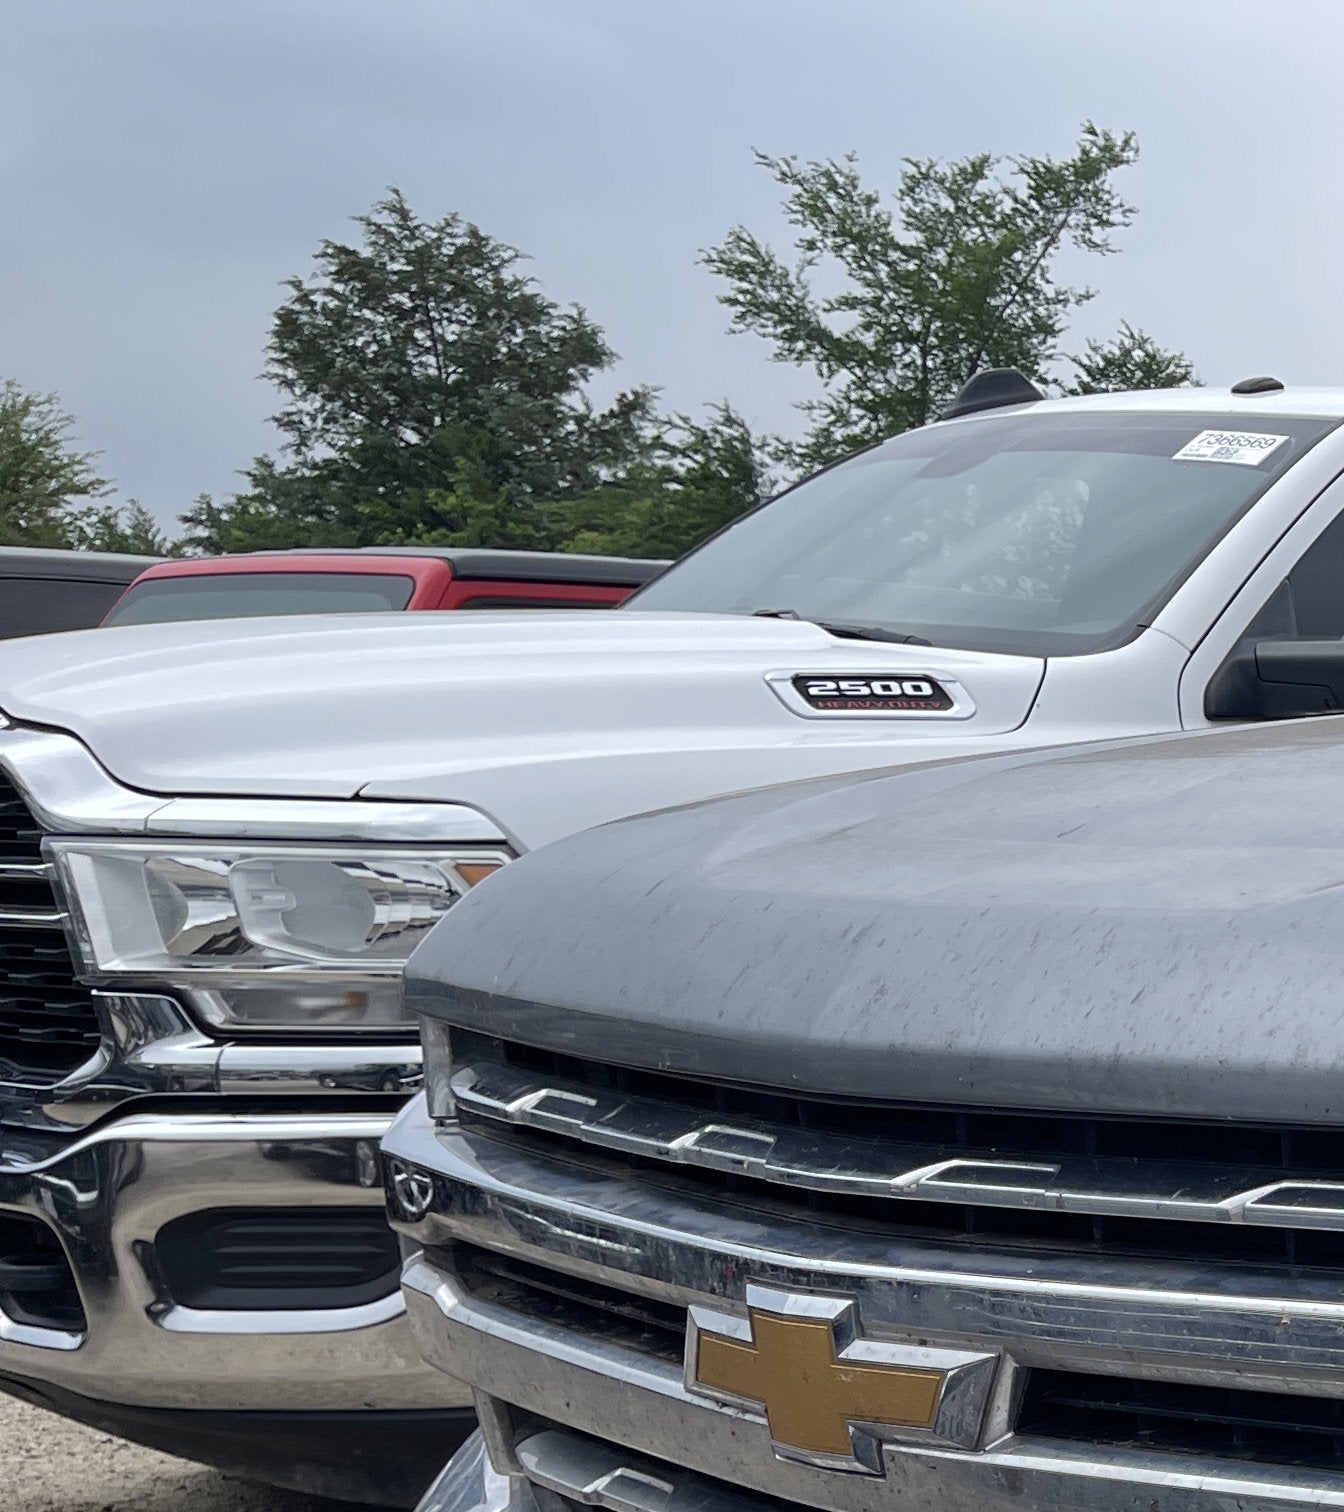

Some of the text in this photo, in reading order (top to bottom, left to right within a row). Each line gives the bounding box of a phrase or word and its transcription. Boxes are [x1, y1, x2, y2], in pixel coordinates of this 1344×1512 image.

[805, 680, 934, 697] 2500
[816, 699, 942, 710] HEAVY DUTY
